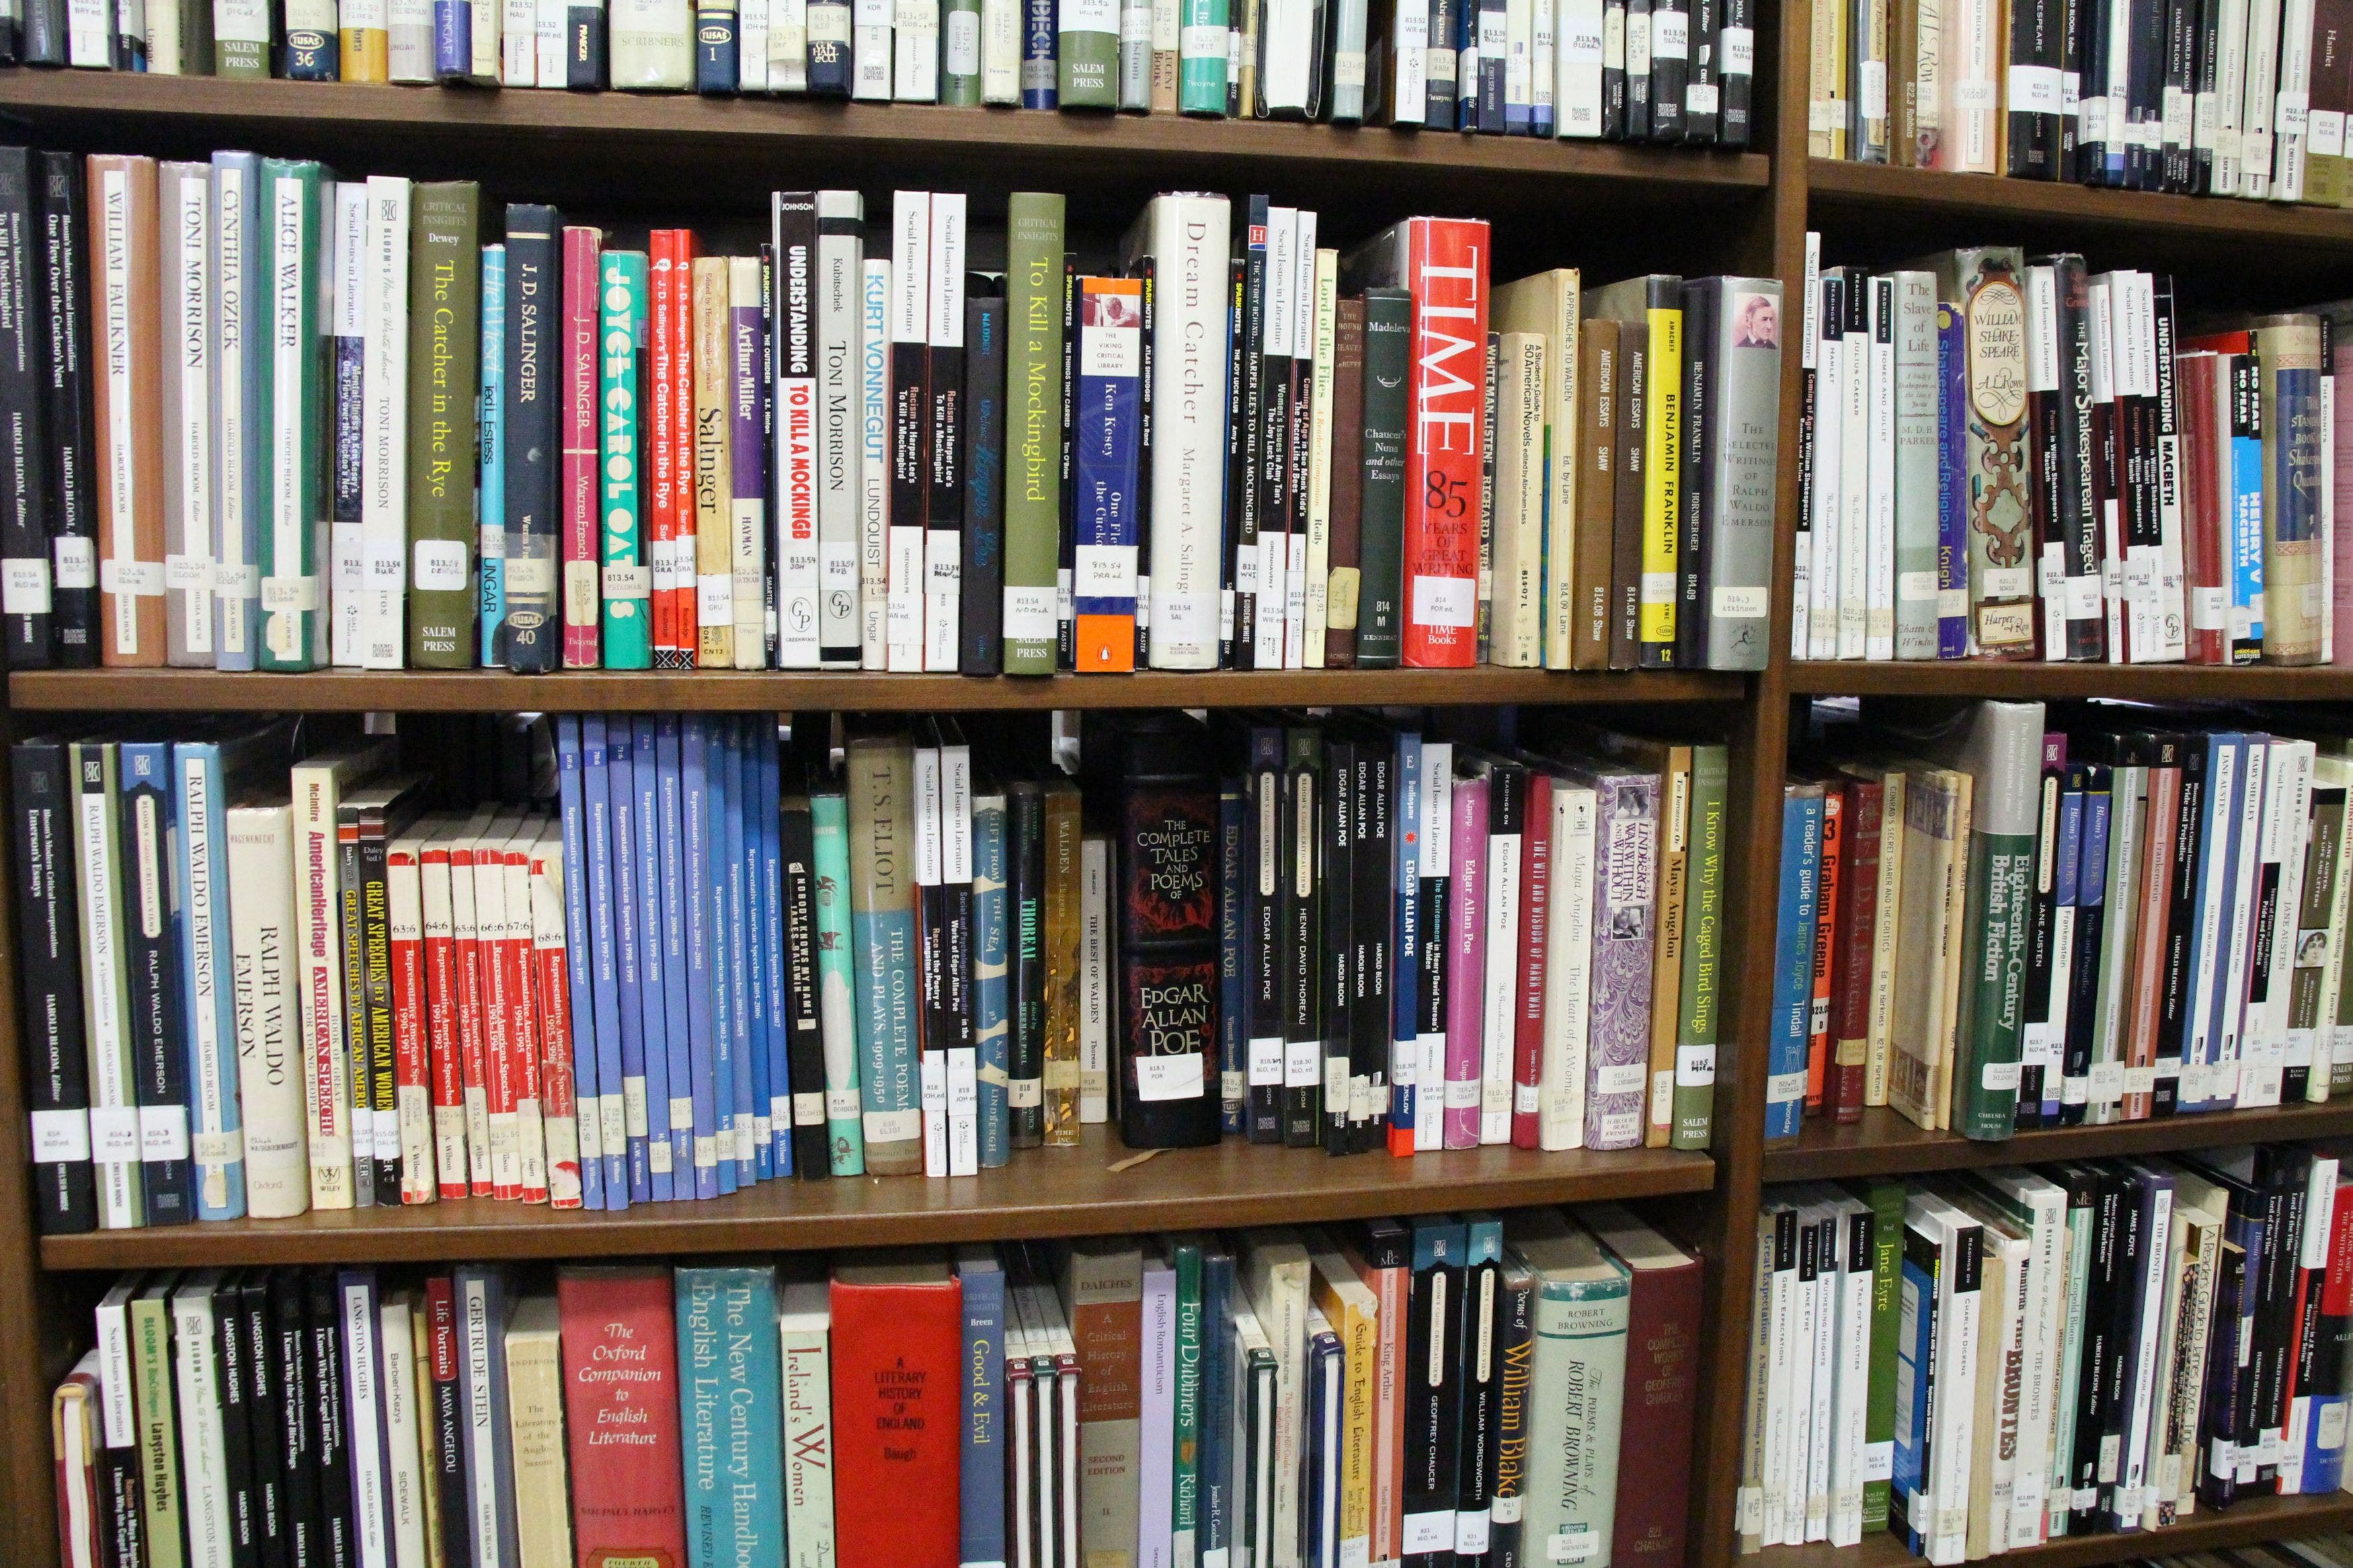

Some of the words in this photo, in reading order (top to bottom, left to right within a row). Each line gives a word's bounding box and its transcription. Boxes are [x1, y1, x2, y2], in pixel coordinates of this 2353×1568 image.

[225, 42, 260, 55] SALEM
[293, 36, 319, 46] TUSAS
[2325, 30, 2336, 67] Hamlet
[225, 56, 259, 69] PRESS
[1073, 65, 1104, 75] SALEM
[1073, 77, 1104, 89] PRESS
[185, 197, 201, 249] TONI
[282, 195, 297, 253] ALICE
[782, 202, 814, 210] JOHNSON
[108, 192, 124, 270] WILLIAM
[223, 190, 239, 283] CYNTHIA
[429, 233, 458, 245] Dewey
[435, 260, 454, 300] The
[1029, 257, 1049, 282] To
[1187, 220, 1207, 308] Dream
[282, 261, 296, 348] WALKER
[832, 257, 843, 313] Kubitschek
[865, 276, 885, 334] KURT
[1909, 284, 1930, 295] The
[186, 260, 203, 368] MORRISON
[224, 290, 238, 350] OZICK
[606, 268, 631, 375] JOYCE
[789, 246, 807, 373] UNDERSTANDING
[1029, 286, 1049, 331] Kill
[1903, 302, 1932, 315] Slave
[1913, 322, 1925, 334] of
[110, 284, 125, 375] FAULKNER
[434, 308, 454, 387] Catcher
[738, 323, 753, 377] Arthur
[1029, 338, 1042, 351] a
[1907, 339, 1929, 352] Life
[521, 305, 536, 403] SALINGER
[828, 340, 847, 387] TONI
[1417, 246, 1478, 456] TIME
[1601, 349, 1611, 393] AMERICAN
[2074, 341, 2089, 393] Major
[1184, 321, 1204, 425] Catcher
[1938, 339, 1949, 441] Shakespeare
[2157, 317, 2172, 432] UNDERSTANDING
[434, 394, 446, 409] in
[740, 381, 752, 419] Miller
[790, 385, 810, 403] TO
[865, 341, 885, 463] VONNEGUT
[1105, 383, 1117, 408] Ken
[1599, 397, 1609, 427] ESSAYS
[434, 416, 452, 454] the
[606, 386, 631, 499] CAROL
[790, 409, 809, 439] KILL
[829, 395, 848, 491] MORRISON
[1023, 360, 1048, 502] Mockingbird
[1103, 415, 1116, 458] Kesey
[1665, 394, 1675, 470] BENJAMIN
[699, 408, 723, 513] Salinger
[791, 444, 809, 455] A
[1598, 446, 1608, 470] SHAW
[1939, 446, 1948, 469] and
[2075, 395, 2095, 517] Shakespearean
[427, 460, 451, 498] Rye
[1425, 470, 1468, 518] 85
[2163, 441, 2173, 506] MACBETH
[866, 479, 880, 568] LUNDQUIST
[1664, 481, 1674, 554] FRANKLIN
[1938, 474, 1950, 532] Religion
[1423, 524, 1467, 535] YEARS
[1422, 549, 1464, 562] GREAT
[422, 626, 456, 638] SALEM
[424, 640, 455, 652] PRESS
[189, 775, 204, 834] RALPH
[308, 782, 319, 822] McIntire
[1137, 830, 1211, 845] COMPLETE
[1165, 820, 1186, 830] THE
[1706, 811, 1720, 848] Know
[191, 842, 207, 907] WALDO
[874, 818, 893, 893] ELIOT
[1150, 847, 1198, 863] TALES
[1166, 864, 1188, 873] AND
[1704, 855, 1719, 880] Why
[1151, 872, 1203, 890] POEMS
[1406, 860, 1415, 895] EDGAR
[1669, 858, 1681, 895] Maya
[1819, 856, 1835, 916] Graham
[1989, 854, 2009, 915] British
[1405, 898, 1414, 935] ALLAN
[1703, 886, 1714, 911] the
[393, 924, 416, 934] 63:6
[426, 921, 448, 932] 64:6
[538, 932, 561, 942] 68:6
[891, 927, 904, 963] THE
[1021, 898, 1037, 962] THOREAU
[1404, 937, 1414, 956] POE
[1667, 901, 1679, 958] Angelou
[1697, 916, 1714, 958] Caged
[1998, 855, 2030, 1032] Eighteenth-Century
[2060, 911, 2070, 968] Frankenstein
[194, 914, 211, 997] EMERSON
[260, 925, 279, 996] RALPH
[1815, 921, 1832, 979] Greene
[1985, 921, 2005, 981] Fiction
[2035, 930, 2044, 968] AUSTEN
[1140, 985, 1209, 1008] EDGAR
[1698, 962, 1712, 991] Bird
[235, 954, 255, 1060] EMERSON
[893, 969, 907, 1057] COMPLETE
[1142, 1006, 1206, 1028] ALLAN
[1692, 996, 1710, 1033] Sings
[1790, 1000, 1804, 1036] Tindall
[263, 1003, 285, 1086] WALDO
[2130, 1209, 2138, 1232] JAMES
[1877, 1242, 1894, 1274] Jane
[727, 1286, 750, 1325] The
[1875, 1277, 1893, 1311] Eyre
[353, 1296, 365, 1357] LANGSTON
[470, 1296, 486, 1378] GERTRUDE
[604, 1323, 633, 1339] The
[688, 1285, 717, 1368] English
[970, 1318, 993, 1326] Breen
[1181, 1302, 1201, 1341] Four
[593, 1346, 646, 1362] Oxford
[728, 1333, 752, 1383] New
[972, 1339, 990, 1387] Good
[357, 1358, 368, 1399] HUGHES
[579, 1367, 662, 1383] Companion
[615, 1389, 629, 1401] to
[1180, 1344, 1199, 1428] Dubliners
[1501, 1340, 1532, 1431] William
[1566, 1360, 1585, 1421] ROBERT
[475, 1385, 487, 1428] STEIN
[597, 1409, 647, 1425] English
[973, 1392, 989, 1407] &
[589, 1432, 656, 1446] Literature
[694, 1378, 714, 1490] Literature
[729, 1389, 754, 1478] Century
[973, 1411, 990, 1445] Evil
[1428, 1446, 1436, 1490] CHAUCER
[1499, 1437, 1525, 1498] Blake
[1561, 1426, 1581, 1510] BROWNING
